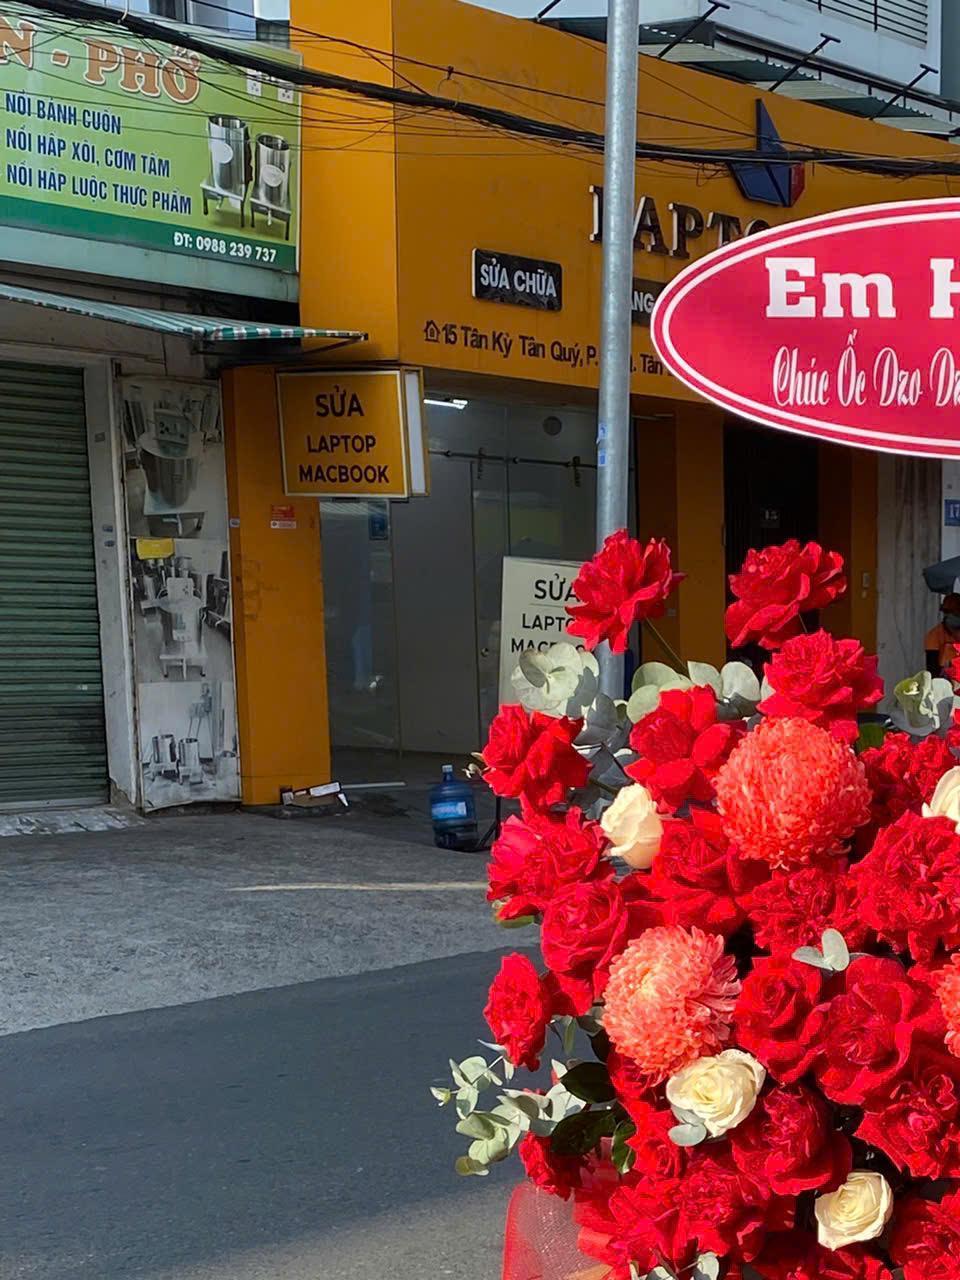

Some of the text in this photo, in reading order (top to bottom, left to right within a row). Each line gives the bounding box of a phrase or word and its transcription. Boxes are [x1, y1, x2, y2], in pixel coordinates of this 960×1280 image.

[37, 96, 77, 127] BÁNH
[82, 106, 121, 135] CUỐN
[72, 139, 100, 167] XÔI,
[104, 148, 136, 172] CƠM
[72, 174, 107, 202] LUỘC
[112, 183, 148, 210] THỰC
[173, 231, 277, 263] ĐT: 0988 239 737
[480, 257, 557, 298] SỬA CHỮA
[765, 257, 896, 318] Em
[442, 323, 457, 345] 15
[461, 326, 488, 350] Tân
[492, 331, 513, 358] Kỳ
[519, 335, 545, 359] Tân
[551, 341, 583, 368] Quý,
[773, 346, 830, 407] Chúc
[837, 329, 866, 407] Ốc
[873, 347, 923, 407] Dzo
[315, 385, 365, 417] SỬA
[306, 434, 376, 453] LAPTOP
[298, 464, 390, 484] MACBOOK
[534, 573, 581, 602] SỬA
